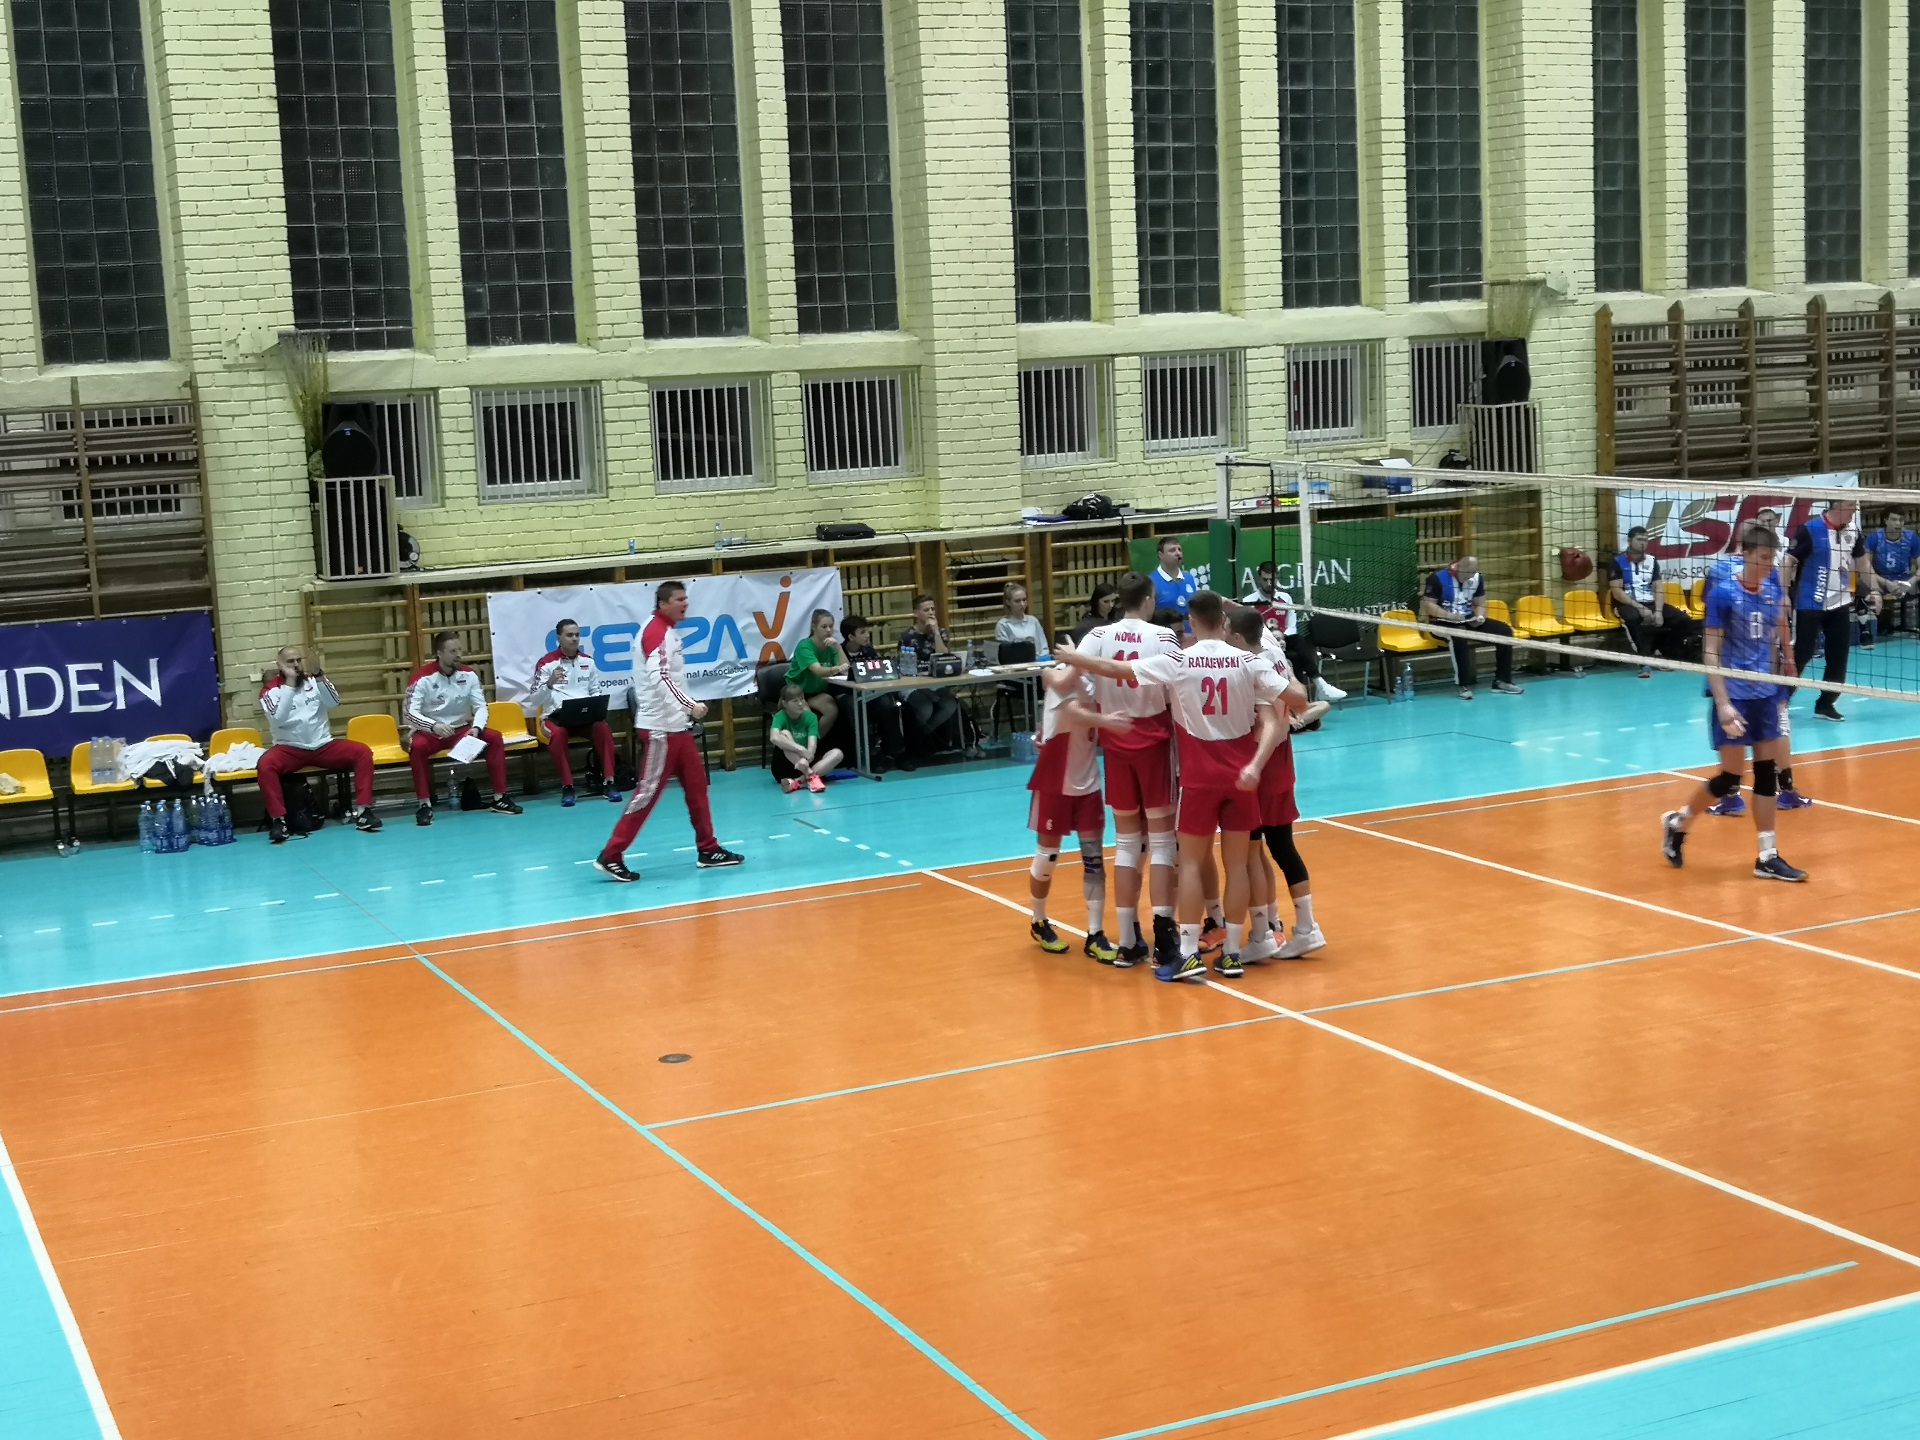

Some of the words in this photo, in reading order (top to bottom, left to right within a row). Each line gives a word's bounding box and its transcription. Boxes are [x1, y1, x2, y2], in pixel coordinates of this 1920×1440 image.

[1886, 551, 1896, 568] 5
[1114, 631, 1142, 643] NOWAK
[702, 665, 749, 679] Association
[856, 661, 867, 676] 5
[882, 659, 893, 674] 3
[0, 658, 162, 720] DEN
[1201, 676, 1228, 715] 21
